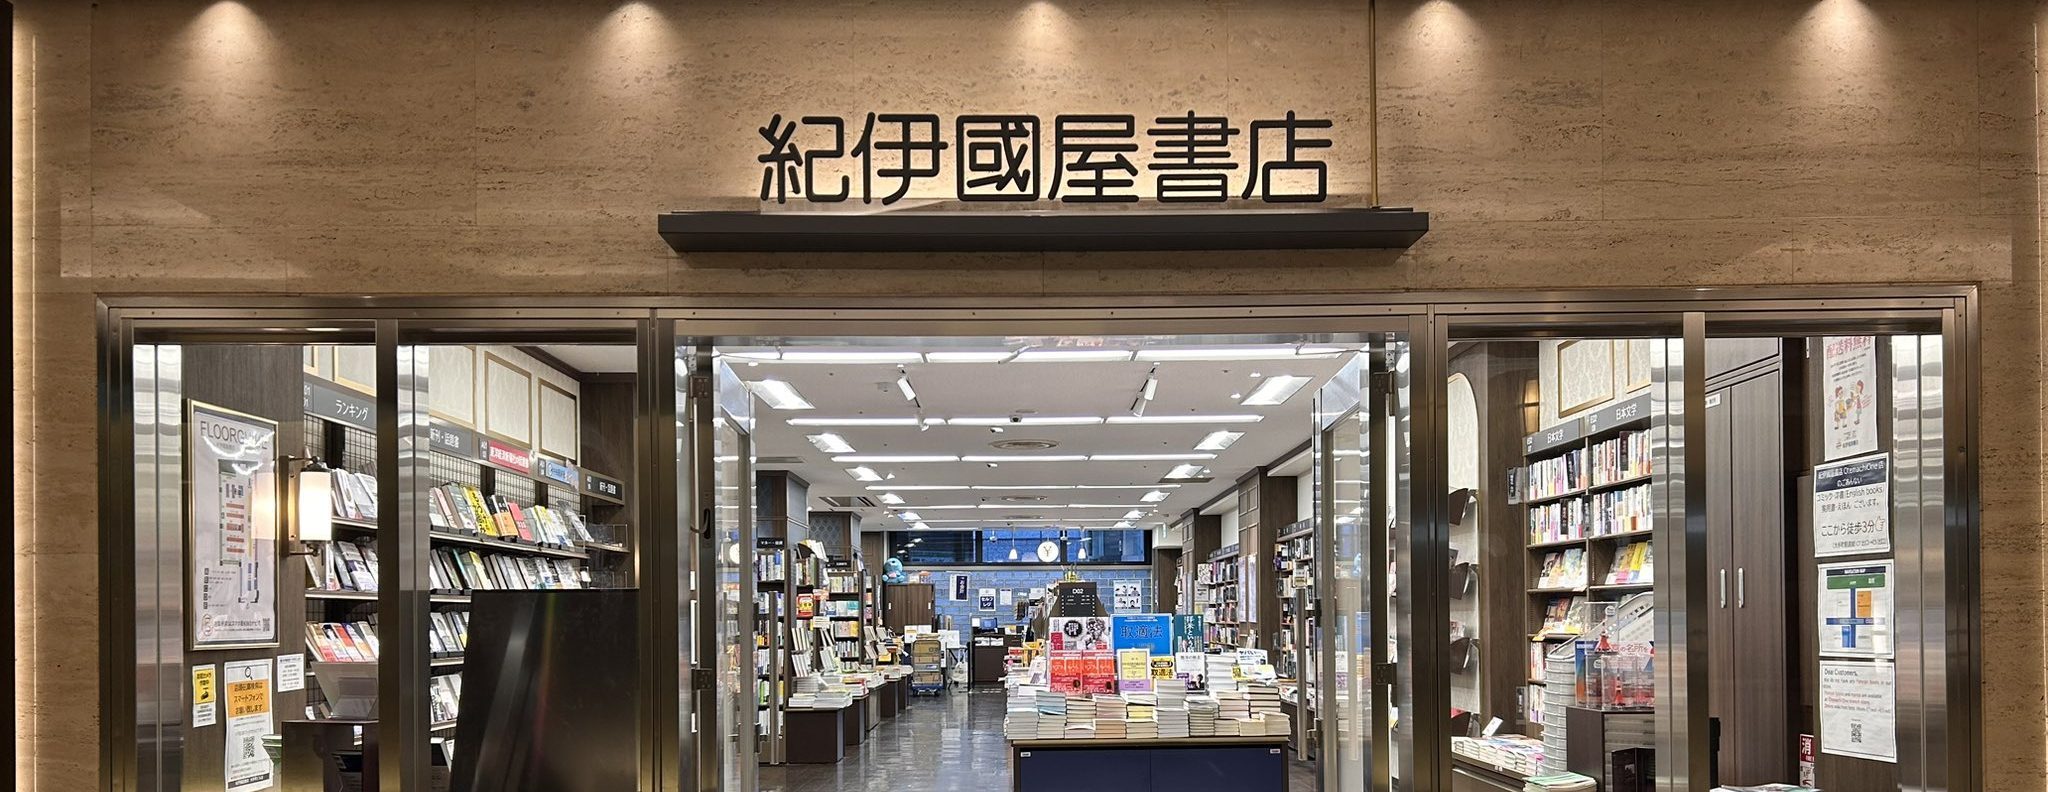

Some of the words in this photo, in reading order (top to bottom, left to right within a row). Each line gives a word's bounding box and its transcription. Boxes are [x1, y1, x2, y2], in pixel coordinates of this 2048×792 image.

[758, 110, 1333, 205] 紀伊國屋書店
[335, 399, 369, 422] ランキング
[1615, 403, 1637, 421] 日本文学
[1547, 429, 1564, 443] 日本文学
[1821, 520, 1875, 537] ここから徒歩3分
[1120, 624, 1164, 639] 取適法
[233, 692, 264, 703] スマートフォンで
